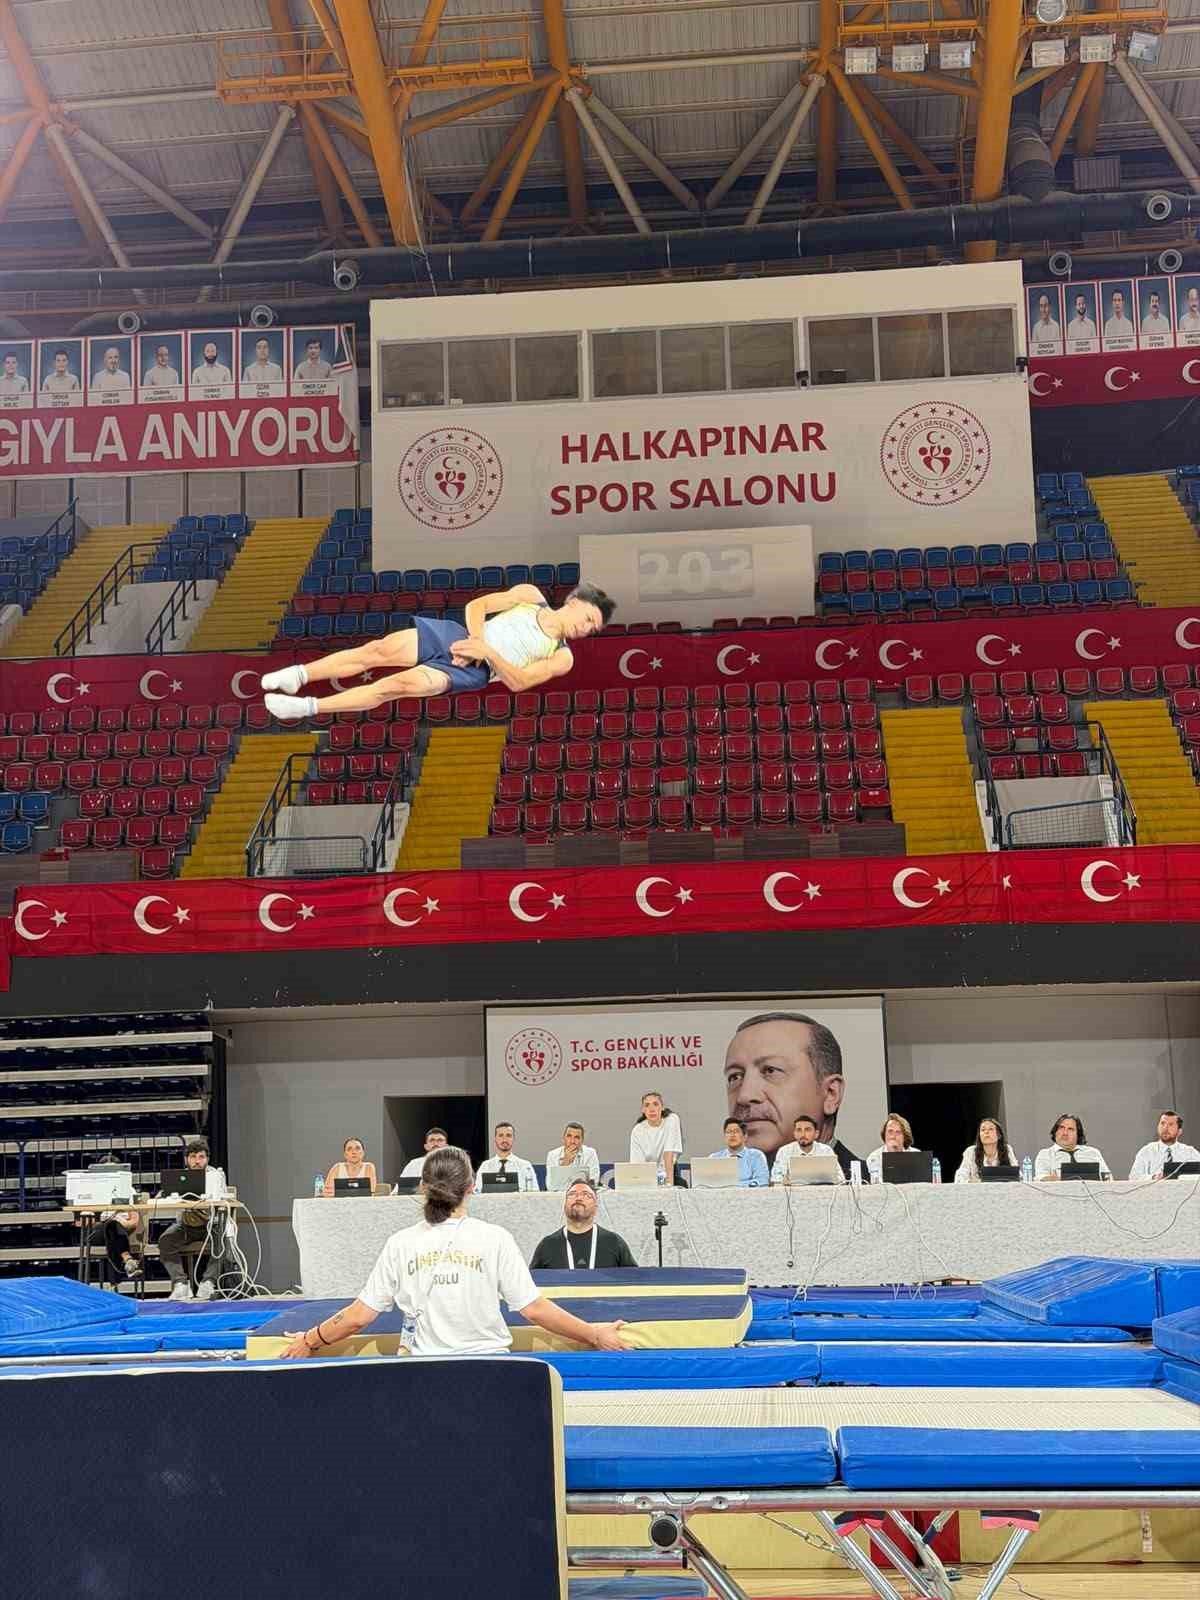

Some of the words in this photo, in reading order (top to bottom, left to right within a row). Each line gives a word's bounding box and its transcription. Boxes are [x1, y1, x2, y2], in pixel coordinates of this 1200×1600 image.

[561, 422, 827, 464] HALKAPINAR
[550, 481, 658, 515] SPOR
[670, 471, 836, 509] SALONU
[640, 549, 752, 594] 203
[570, 1039, 600, 1053] T.C.
[604, 1034, 676, 1053] GENÇLİK
[681, 1036, 702, 1049] VE
[571, 1058, 613, 1072] SPOR
[617, 1052, 704, 1069] BAKANLIĞI
